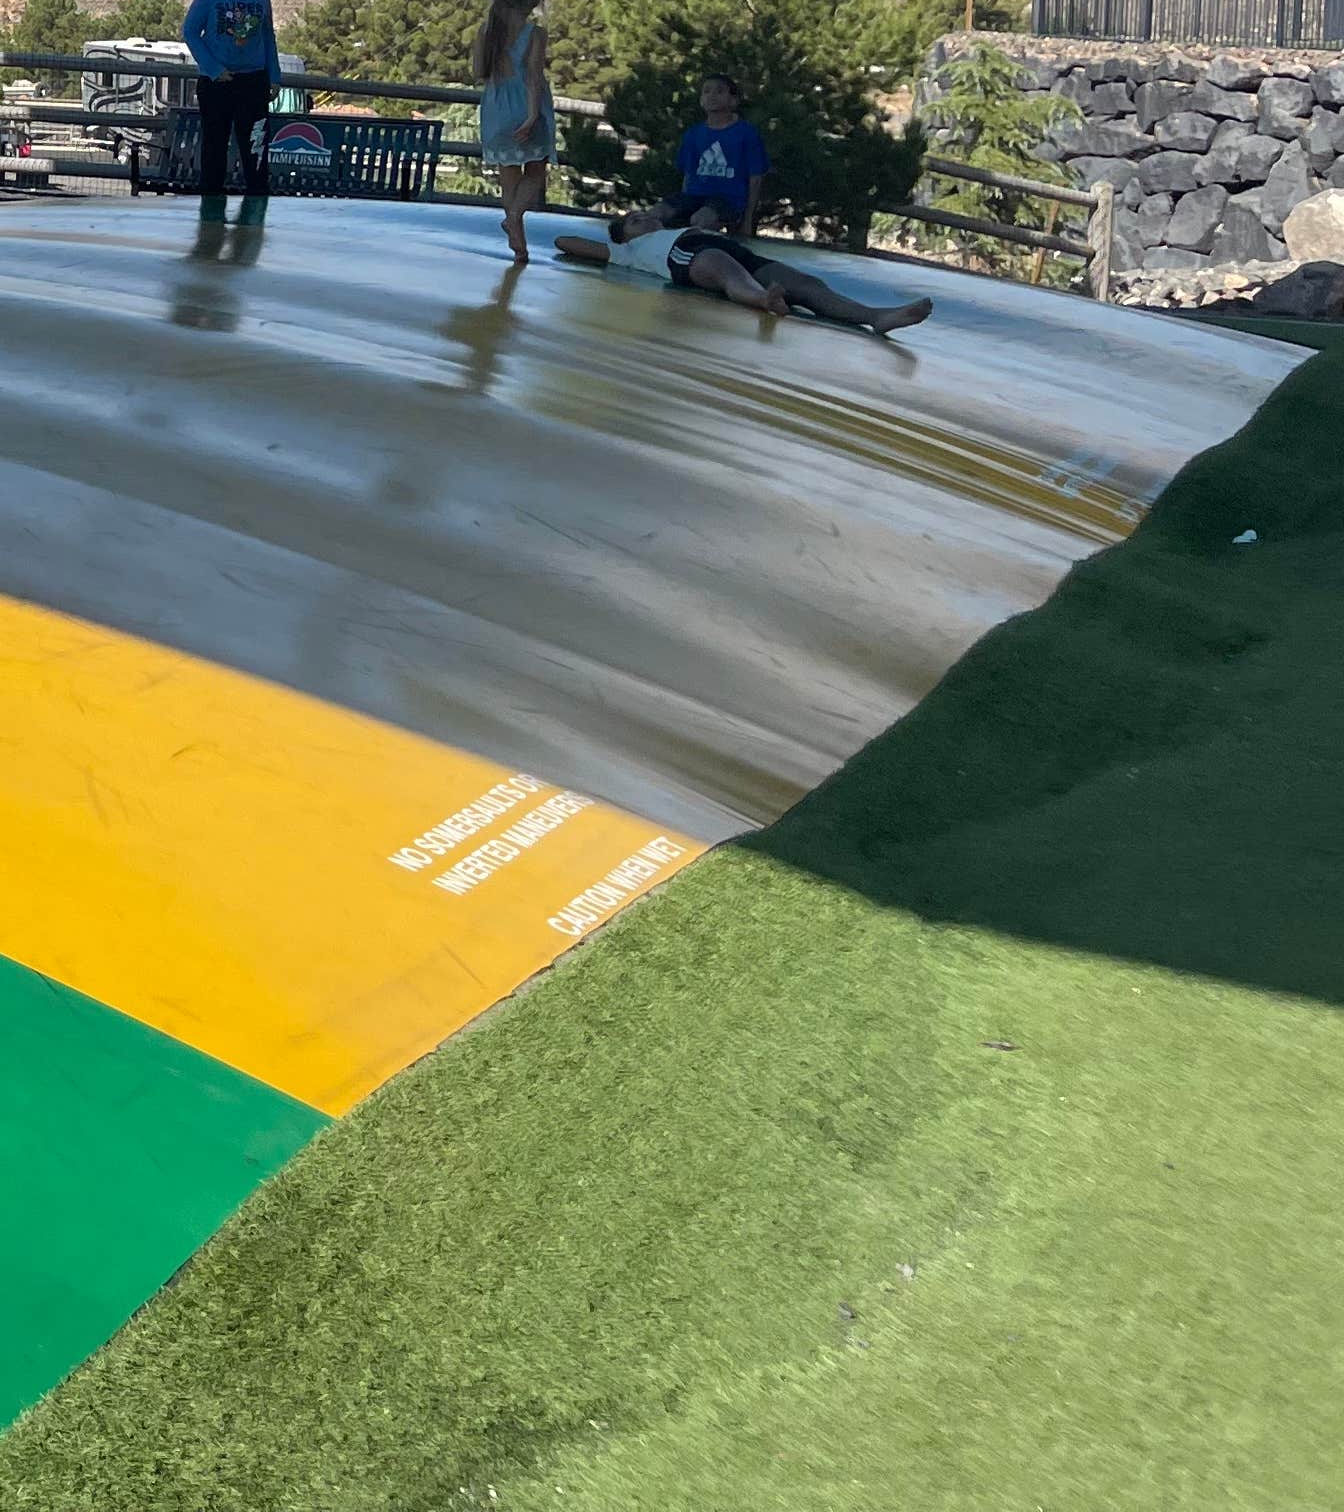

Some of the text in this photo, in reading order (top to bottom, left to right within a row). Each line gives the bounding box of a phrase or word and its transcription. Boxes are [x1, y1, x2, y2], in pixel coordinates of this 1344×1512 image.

[387, 774, 549, 872] NO SOMERSAULTS OR
[432, 790, 595, 895] INVERTED MANEUVERS
[547, 836, 688, 935] CAUTION WHEN WET
